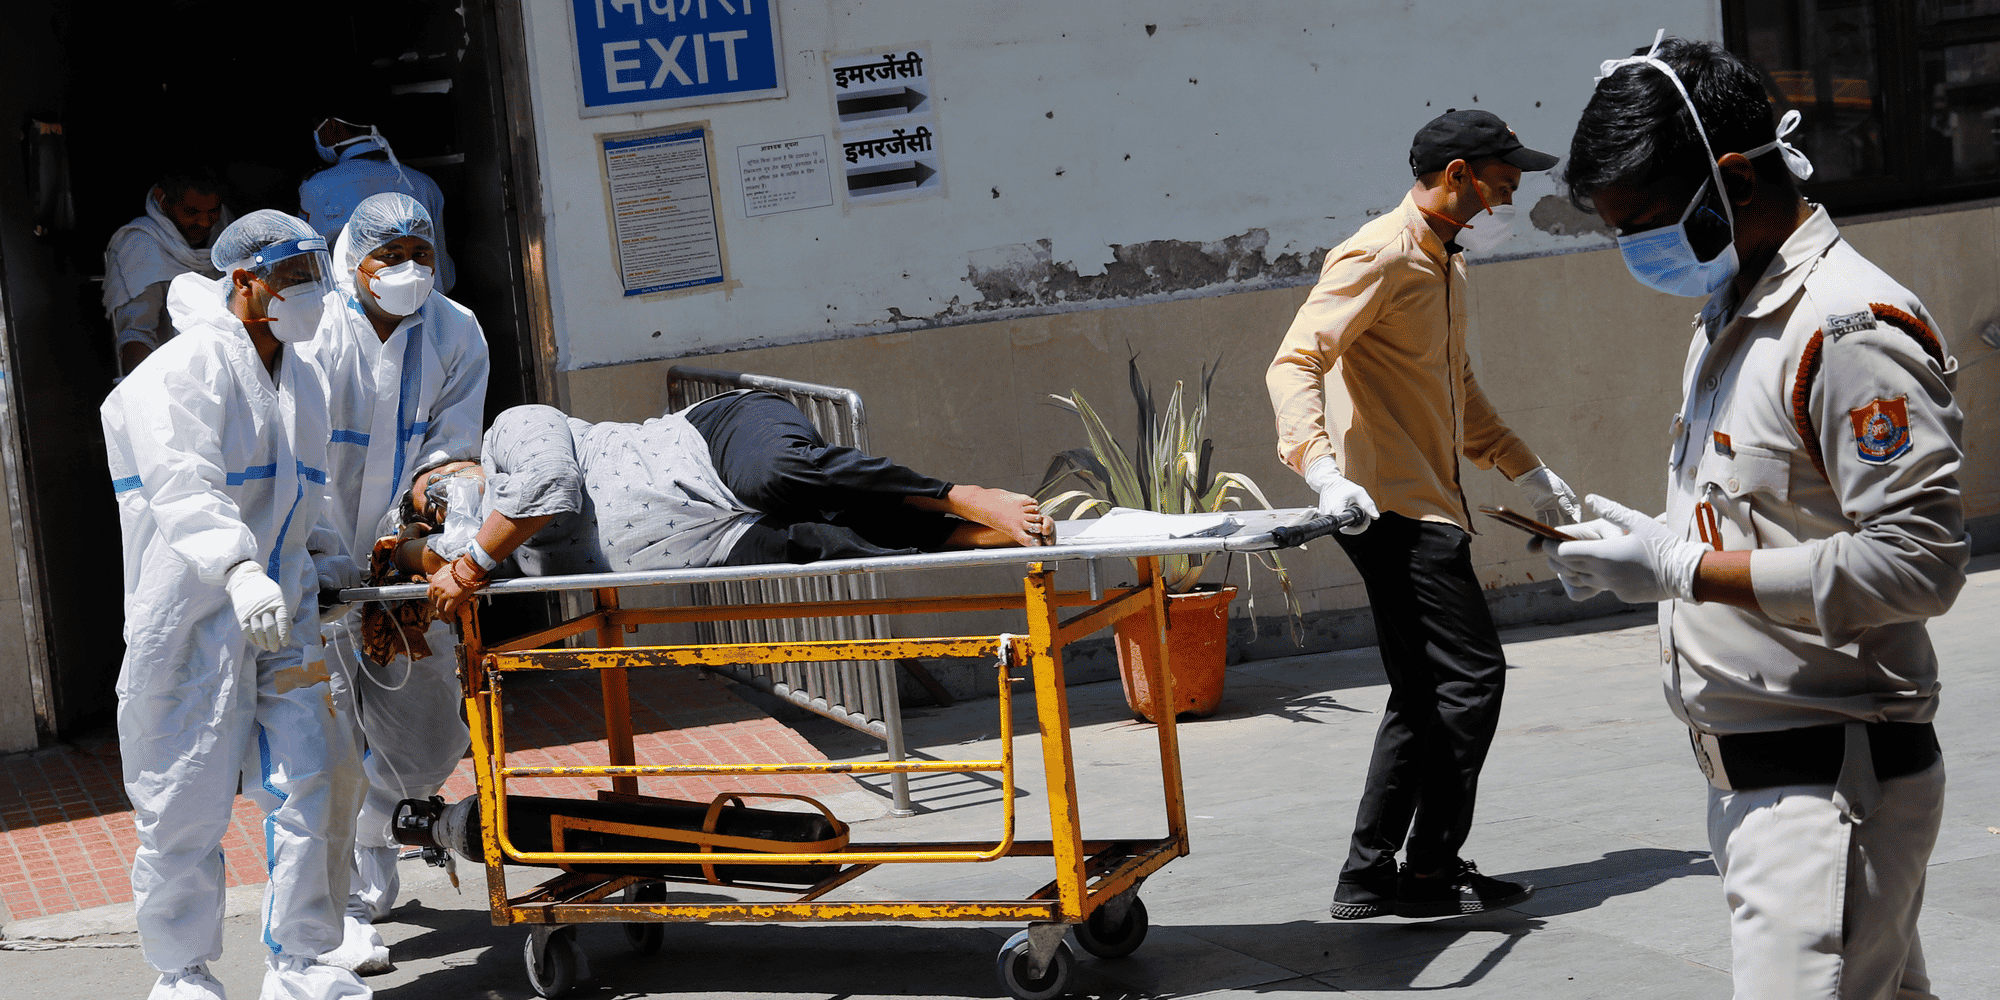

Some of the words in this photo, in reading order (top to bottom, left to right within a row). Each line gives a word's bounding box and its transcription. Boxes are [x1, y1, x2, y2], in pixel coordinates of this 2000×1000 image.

[602, 30, 748, 93] EXIT
[833, 52, 922, 88] इमरजेंसी
[843, 126, 932, 164] इमरजेंसी
